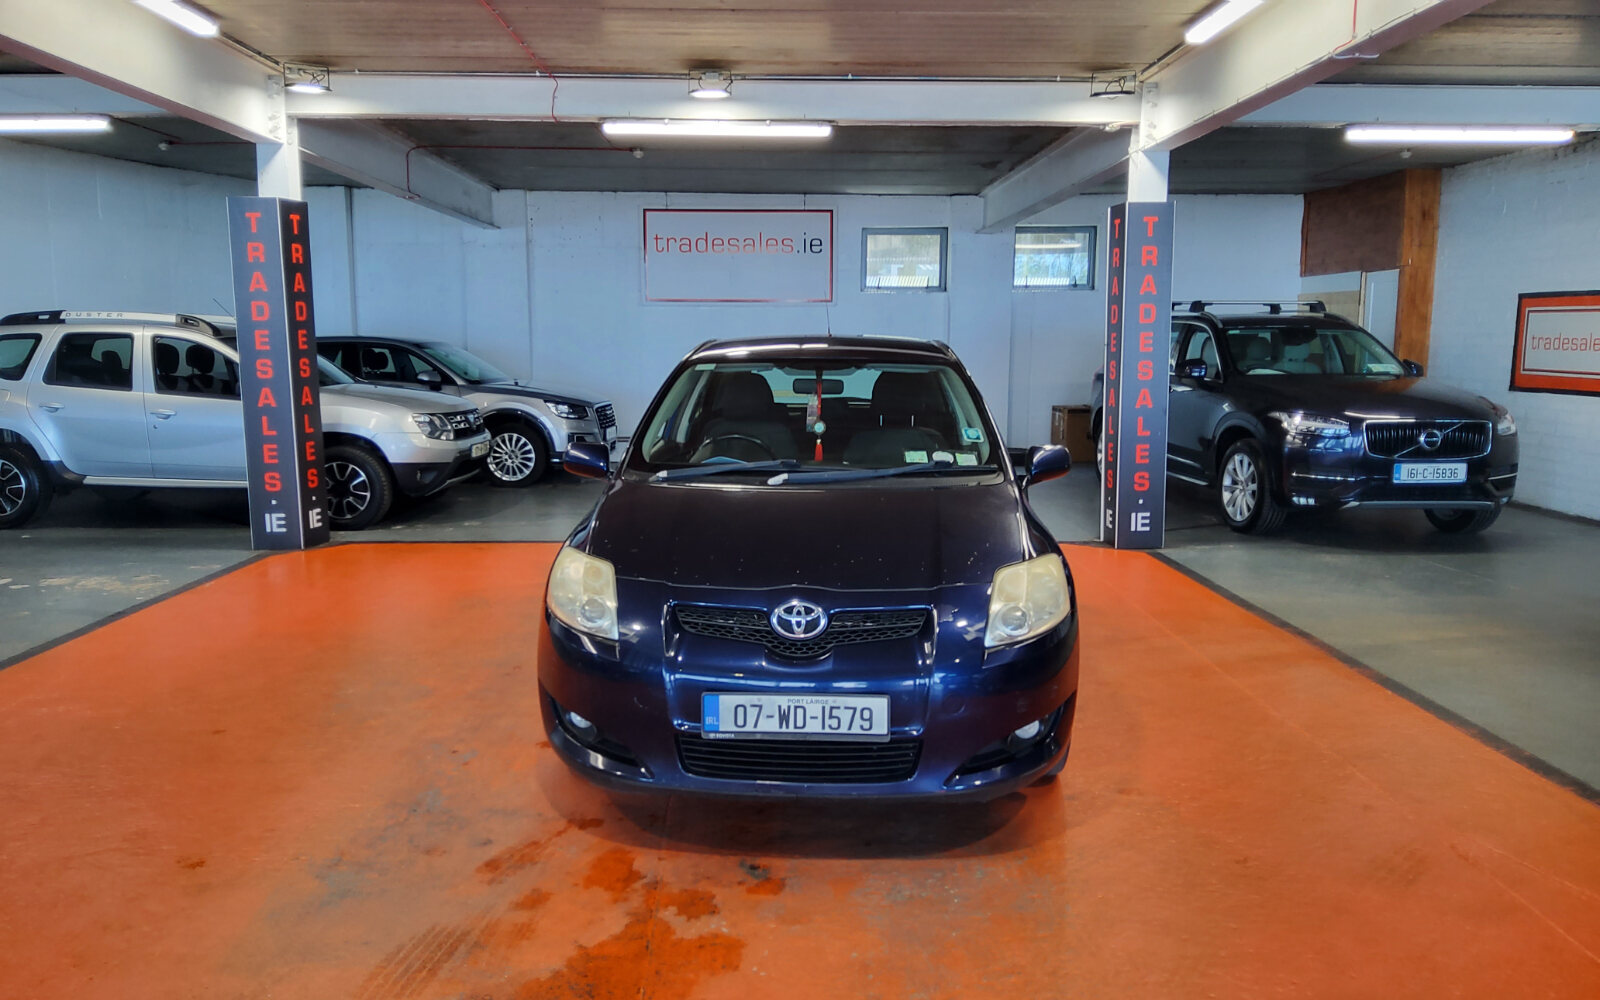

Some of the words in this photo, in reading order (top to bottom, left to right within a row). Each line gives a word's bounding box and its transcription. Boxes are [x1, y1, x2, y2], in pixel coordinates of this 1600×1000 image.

[245, 211, 288, 533] TRADESALES.IE
[290, 213, 323, 529] TRADESALES.IE
[653, 232, 823, 254] tradesales.ie
[1106, 218, 1121, 529] TRADESALES.IE
[1130, 216, 1159, 532] TRADESALES.IE
[1407, 467, 1459, 479] 161-C-15836
[733, 704, 874, 731] 07-WD-1579
